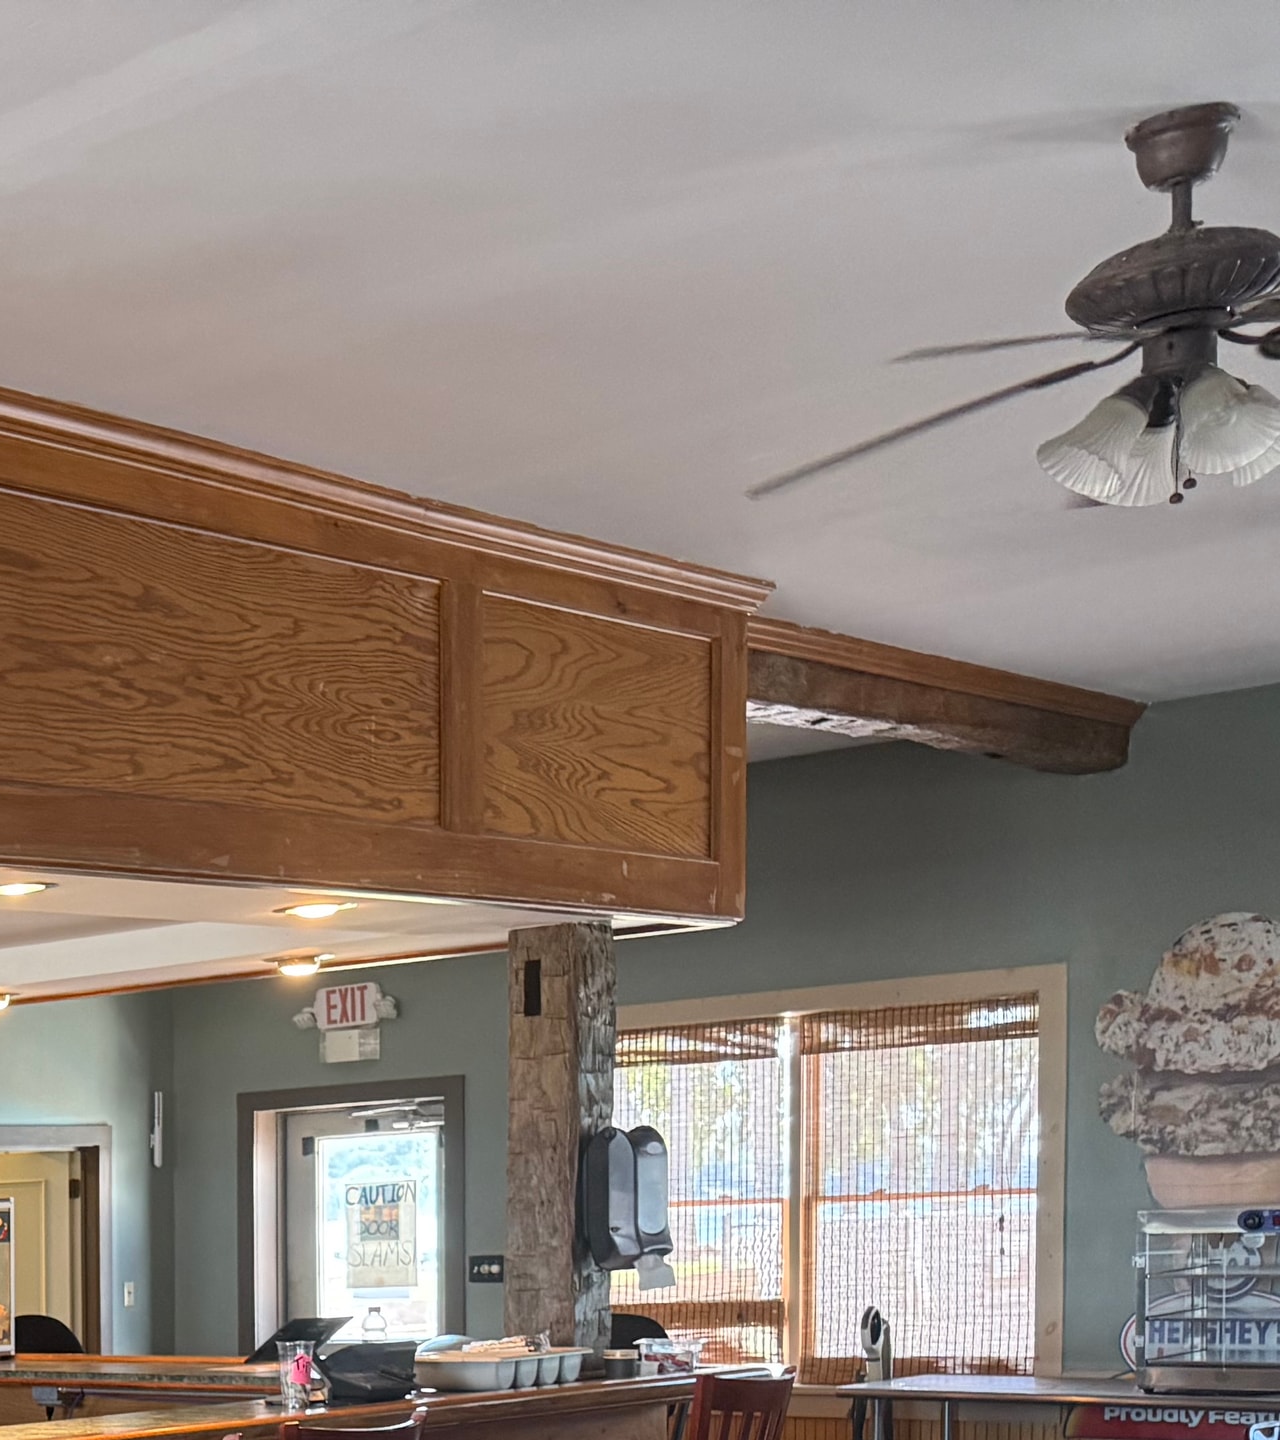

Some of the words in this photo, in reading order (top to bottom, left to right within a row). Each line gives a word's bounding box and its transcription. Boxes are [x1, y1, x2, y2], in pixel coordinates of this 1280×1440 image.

[325, 985, 368, 1025] EXIT
[345, 1181, 416, 1206] CAUTION
[356, 1219, 399, 1237] DOOR
